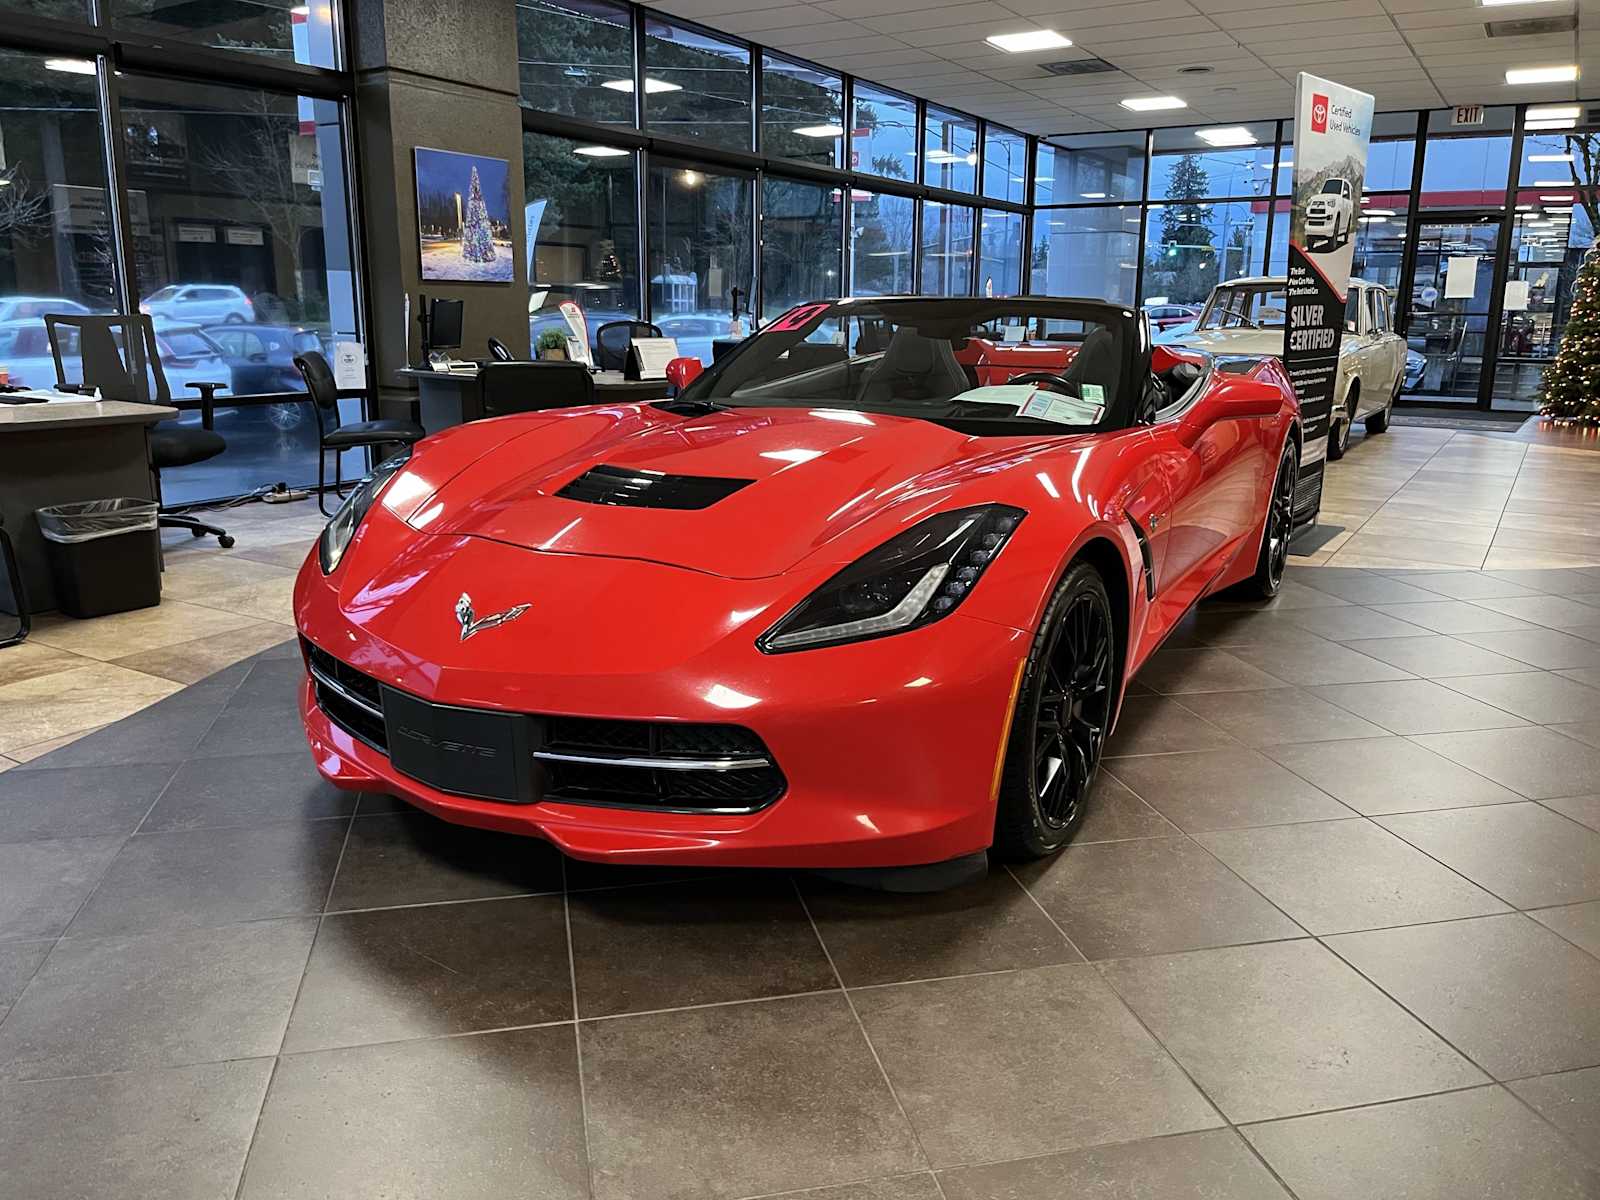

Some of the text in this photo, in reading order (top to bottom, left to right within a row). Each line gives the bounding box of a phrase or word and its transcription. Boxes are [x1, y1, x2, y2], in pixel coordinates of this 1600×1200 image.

[1331, 104, 1352, 119] Certified
[1456, 107, 1480, 123] EXIT
[1329, 119, 1343, 132] Used
[1290, 304, 1324, 328] SILVER
[1290, 328, 1335, 351] CERTIFIED
